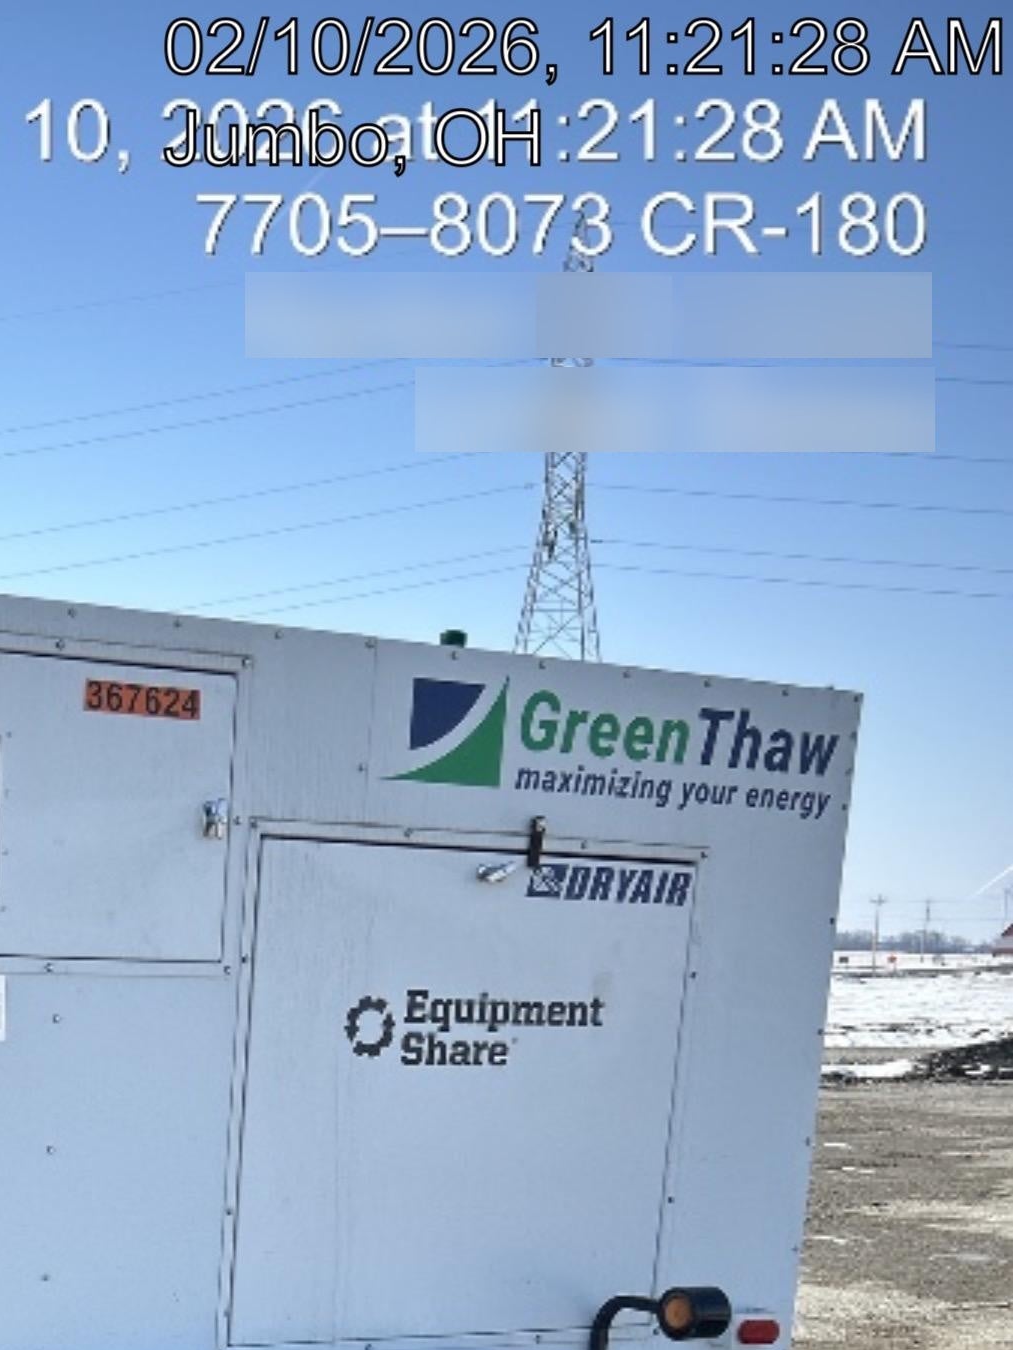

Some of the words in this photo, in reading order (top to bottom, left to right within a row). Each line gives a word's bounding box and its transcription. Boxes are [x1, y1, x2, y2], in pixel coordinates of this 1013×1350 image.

[87, 681, 198, 718] 367624
[515, 766, 672, 808] maximizing
[681, 780, 738, 811] your
[745, 788, 831, 820] energy
[564, 865, 692, 906] DRYAIR
[404, 989, 605, 1032] Equipment
[400, 1032, 509, 1066] Share
